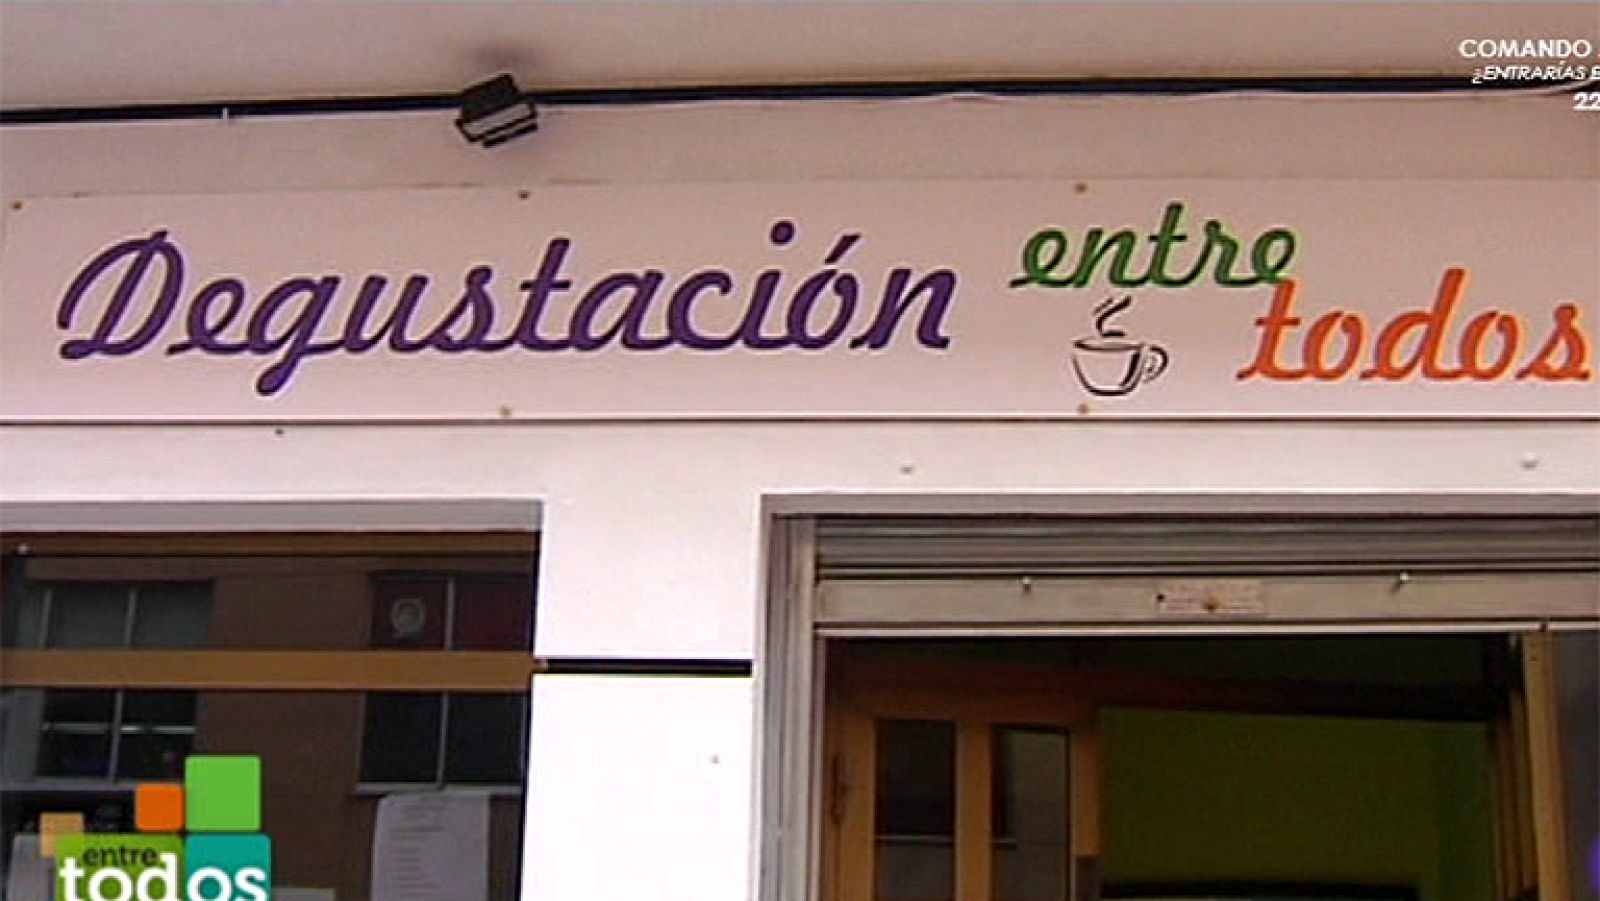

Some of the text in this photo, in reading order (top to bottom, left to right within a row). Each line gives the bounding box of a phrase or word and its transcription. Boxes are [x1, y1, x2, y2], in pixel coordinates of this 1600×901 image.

[1009, 202, 1295, 288] entre
[57, 221, 956, 395] Degustación
[1236, 268, 1590, 380] todos
